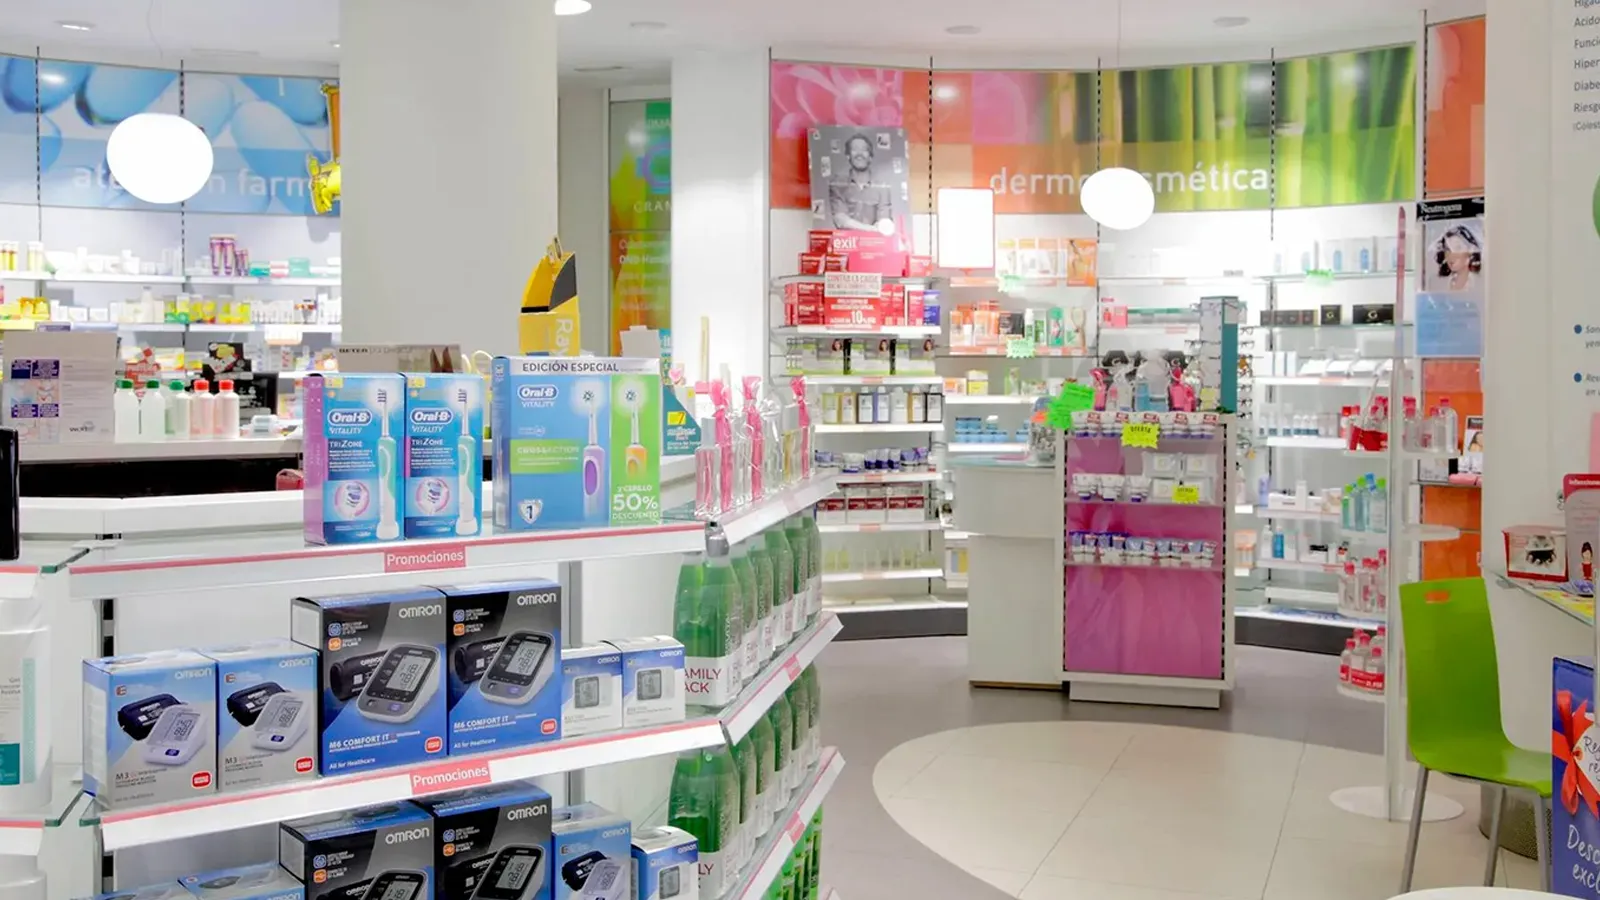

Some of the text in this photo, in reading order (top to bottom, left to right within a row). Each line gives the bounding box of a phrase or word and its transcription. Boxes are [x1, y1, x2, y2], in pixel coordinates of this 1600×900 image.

[522, 359, 619, 372] EDICIÓN ESPECIAL
[331, 412, 369, 423] Oral-B
[414, 411, 450, 422] Oral-B
[329, 427, 362, 435] VITALITY
[412, 425, 444, 433] VITALITY
[613, 493, 658, 511] 50%
[386, 551, 464, 568] Promociones
[685, 668, 722, 680] AMILY
[684, 682, 709, 694] ACK
[343, 735, 380, 747] COMFORT
[413, 766, 488, 787] Promociones
